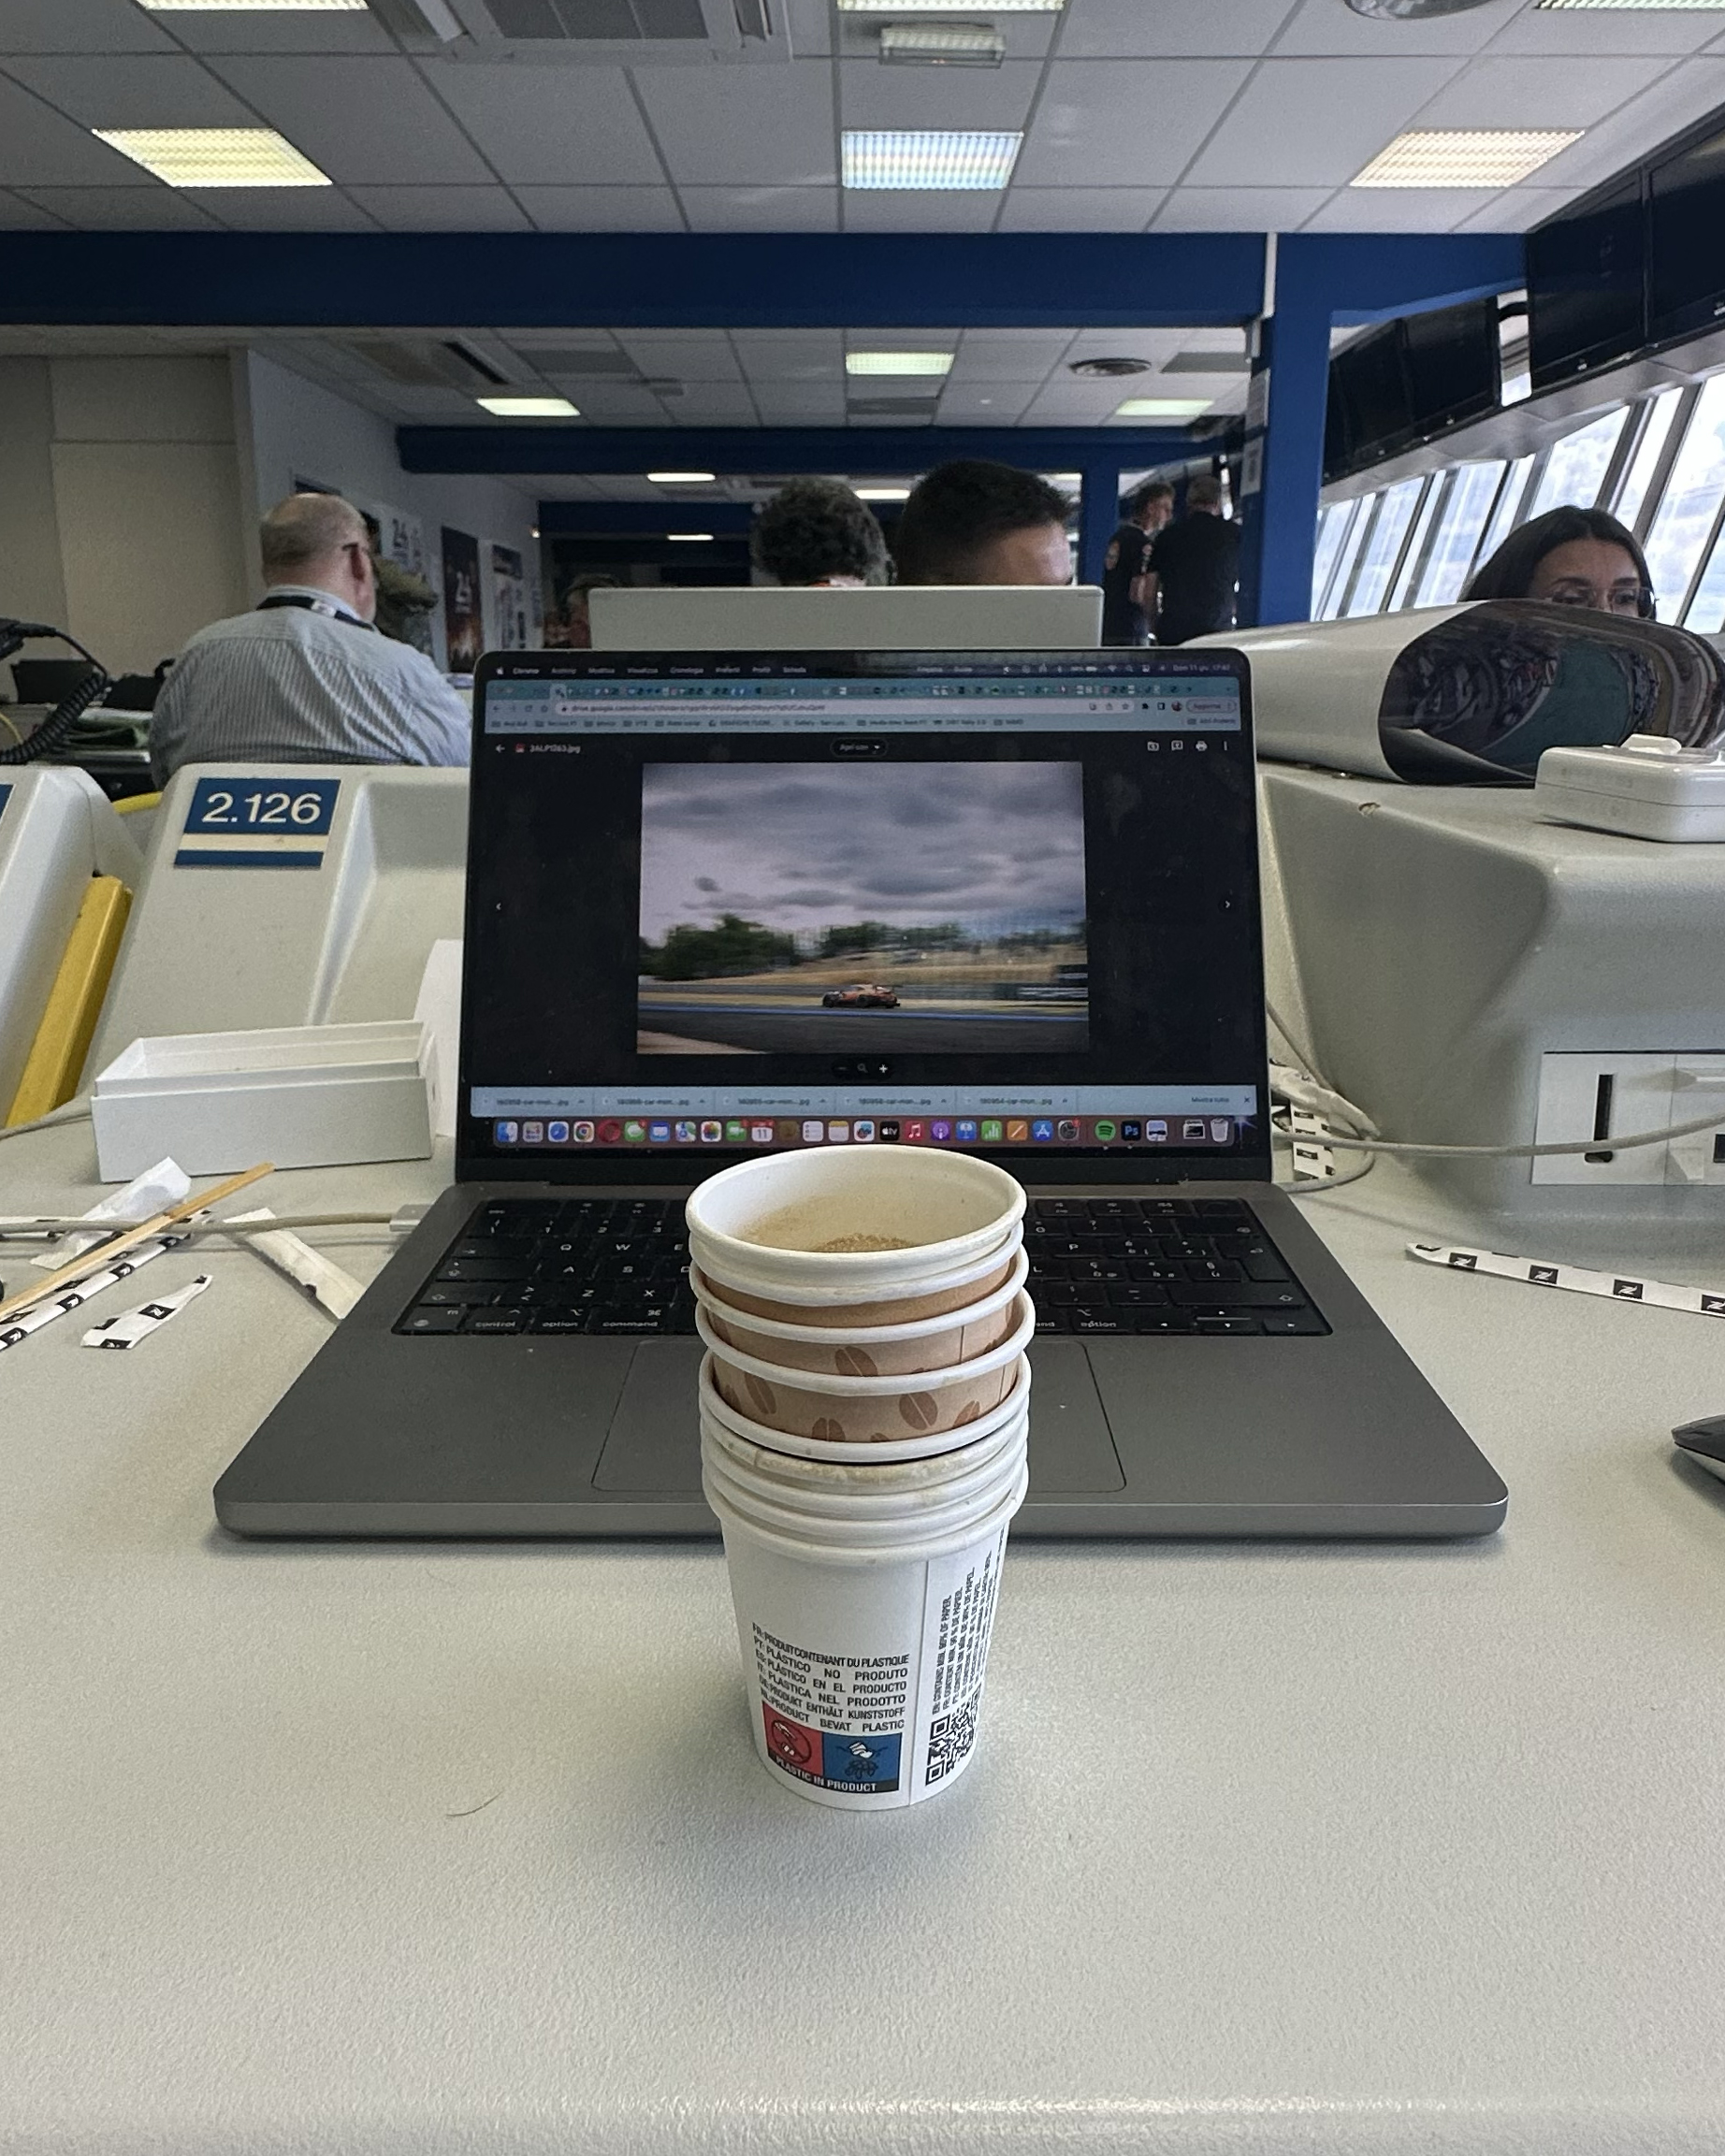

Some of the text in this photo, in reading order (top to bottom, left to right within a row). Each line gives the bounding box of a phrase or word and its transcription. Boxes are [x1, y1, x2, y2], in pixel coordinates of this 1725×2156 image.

[201, 791, 322, 824] 2.126
[757, 1129, 767, 1138] 11
[1125, 1125, 1138, 1136] Ps
[582, 1289, 595, 1297] Z
[644, 1289, 655, 1297] X
[847, 1657, 861, 1668] DU
[861, 1653, 910, 1668] PLASTIQUE
[824, 1668, 841, 1679] NO
[854, 1668, 908, 1681] PRODUTO
[768, 1671, 812, 1699] PLASTICA
[819, 1693, 840, 1704] NEL
[847, 1694, 906, 1707] PRODOTTO
[813, 1678, 826, 1689] EN
[834, 1682, 846, 1693] EL
[852, 1681, 906, 1694] PRODUCTO
[806, 1702, 844, 1717] ENTHÄLT
[848, 1706, 906, 1719] KUNSTSTOFF
[819, 1718, 852, 1732] BEVAT
[862, 1719, 905, 1732] PLASTIC
[776, 1756, 877, 1792] PLASTIC IN PRODUCT
